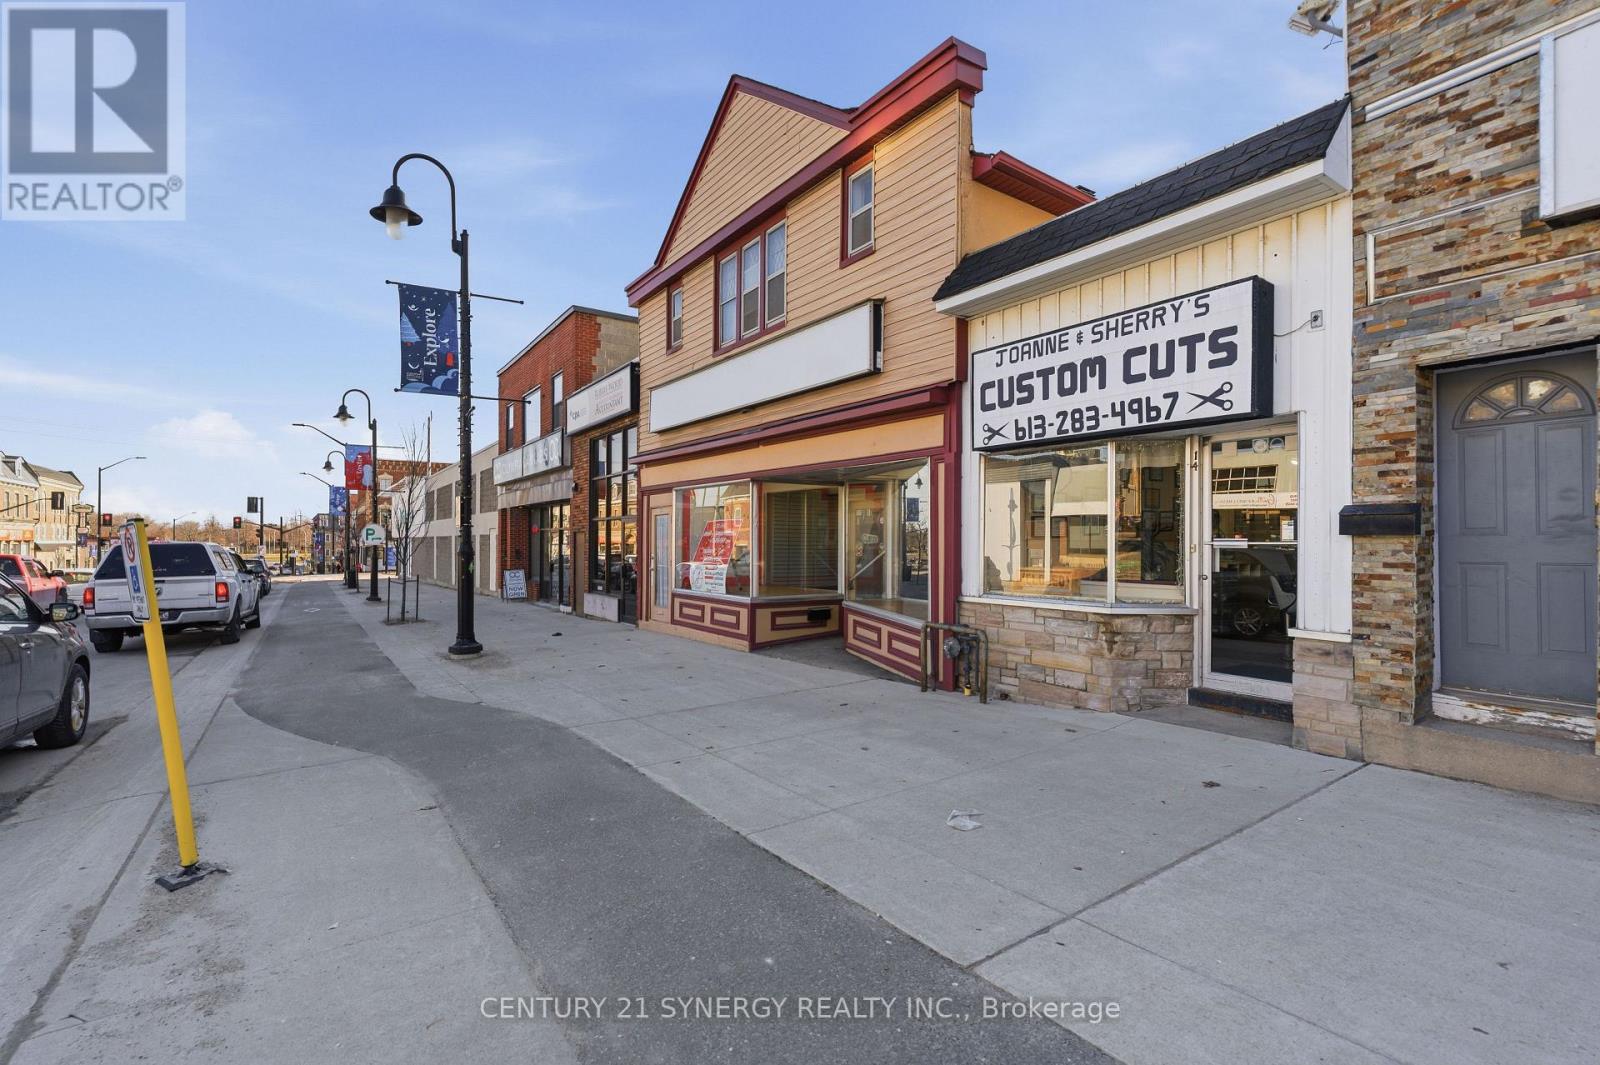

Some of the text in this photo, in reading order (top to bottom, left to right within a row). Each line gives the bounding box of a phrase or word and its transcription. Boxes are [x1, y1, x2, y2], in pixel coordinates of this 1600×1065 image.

[422, 307, 440, 366] Explore
[995, 293, 1211, 368] JOANNE & SHERRY'S
[979, 325, 1239, 413] CUSTOM CUTS
[1014, 391, 1180, 441] 613-283-4967
